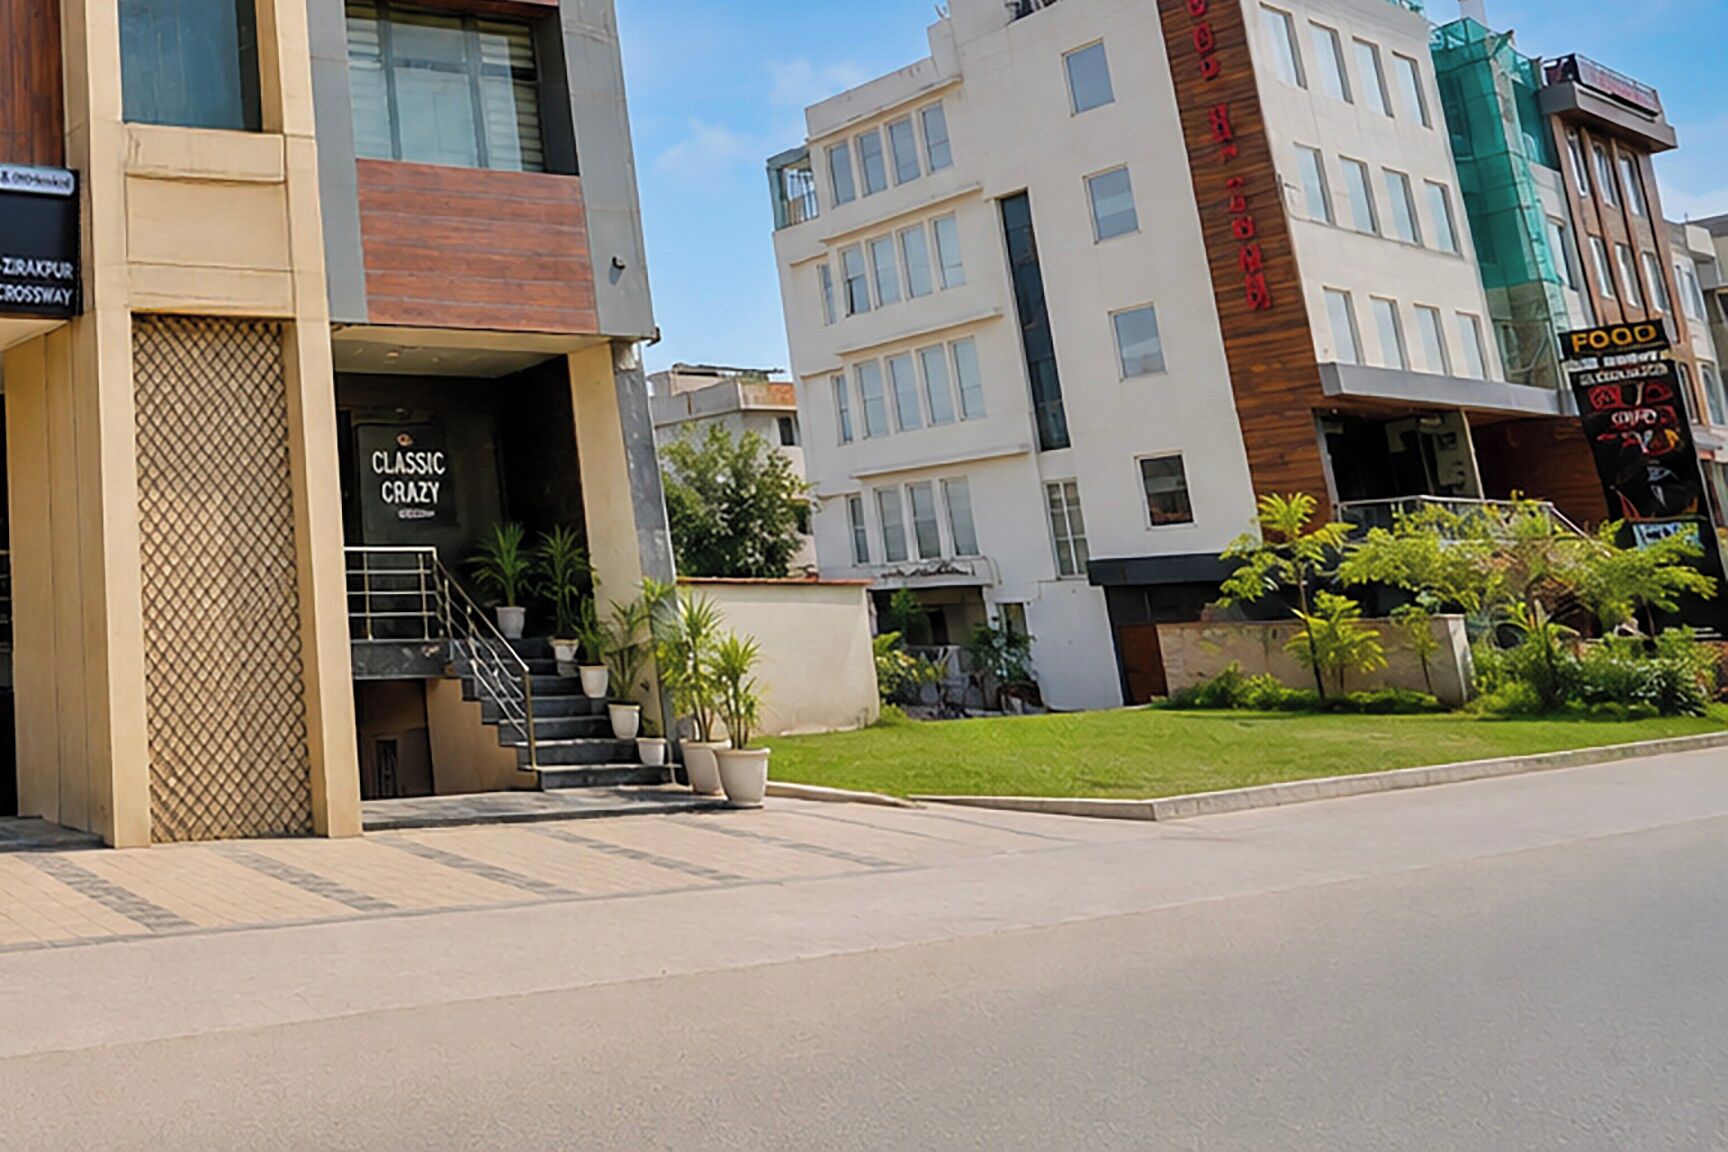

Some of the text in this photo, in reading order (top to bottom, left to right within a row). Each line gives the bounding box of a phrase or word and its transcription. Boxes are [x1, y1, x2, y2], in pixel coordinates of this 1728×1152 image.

[1571, 324, 1658, 353] FOOD
[372, 451, 446, 475] CLASSIC
[381, 480, 440, 504] CRAZY
